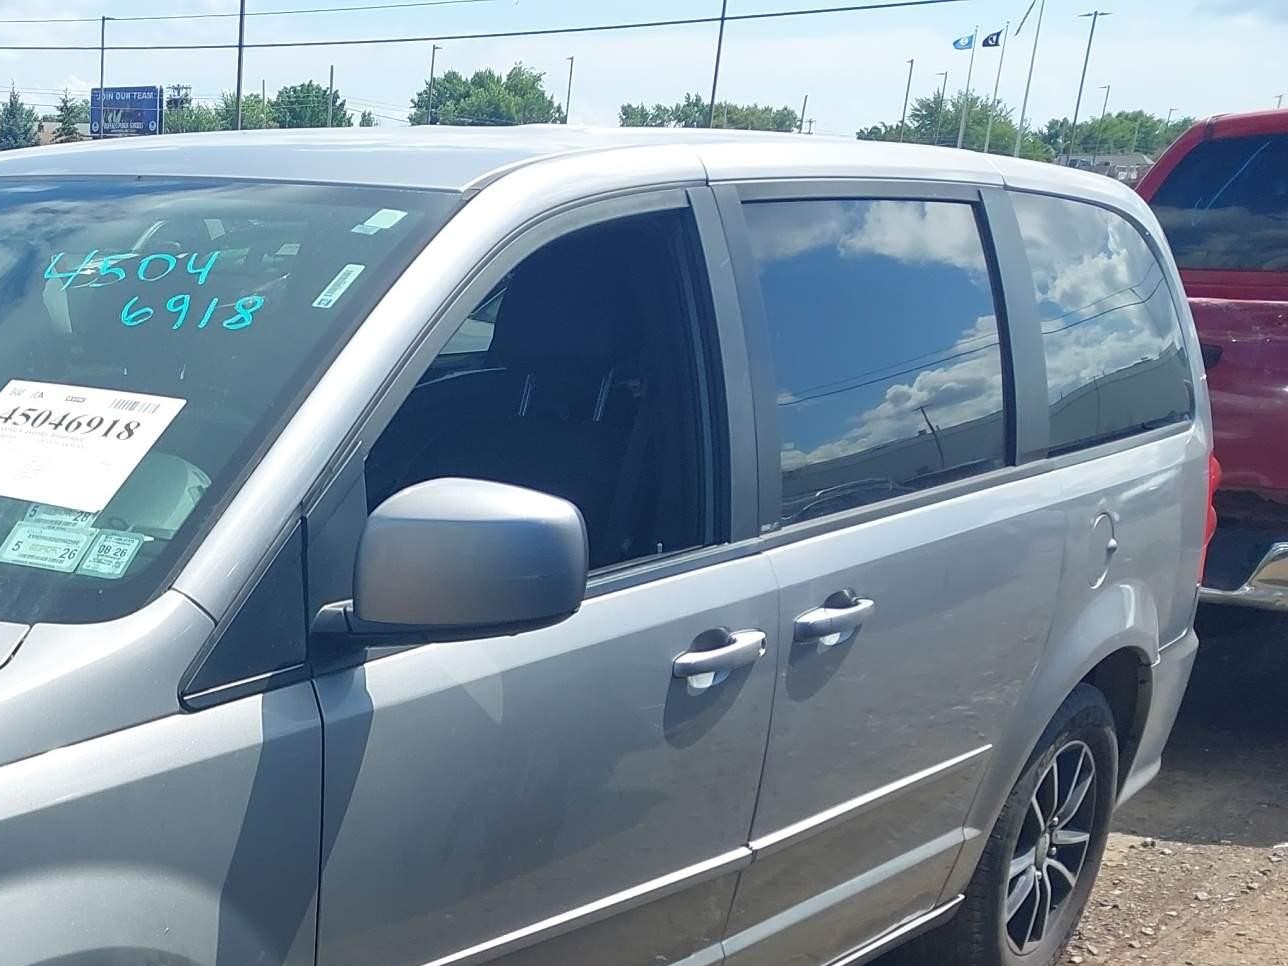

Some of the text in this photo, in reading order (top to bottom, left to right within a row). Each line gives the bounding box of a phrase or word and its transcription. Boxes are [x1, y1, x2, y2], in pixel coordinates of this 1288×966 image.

[96, 91, 153, 100] JOIN OUR TEAM
[44, 250, 221, 291] 4504
[121, 294, 266, 330] 6918
[29, 505, 39, 518] 5
[11, 541, 23, 552] 5
[59, 547, 78, 560] 26
[98, 544, 127, 557] 08 26
